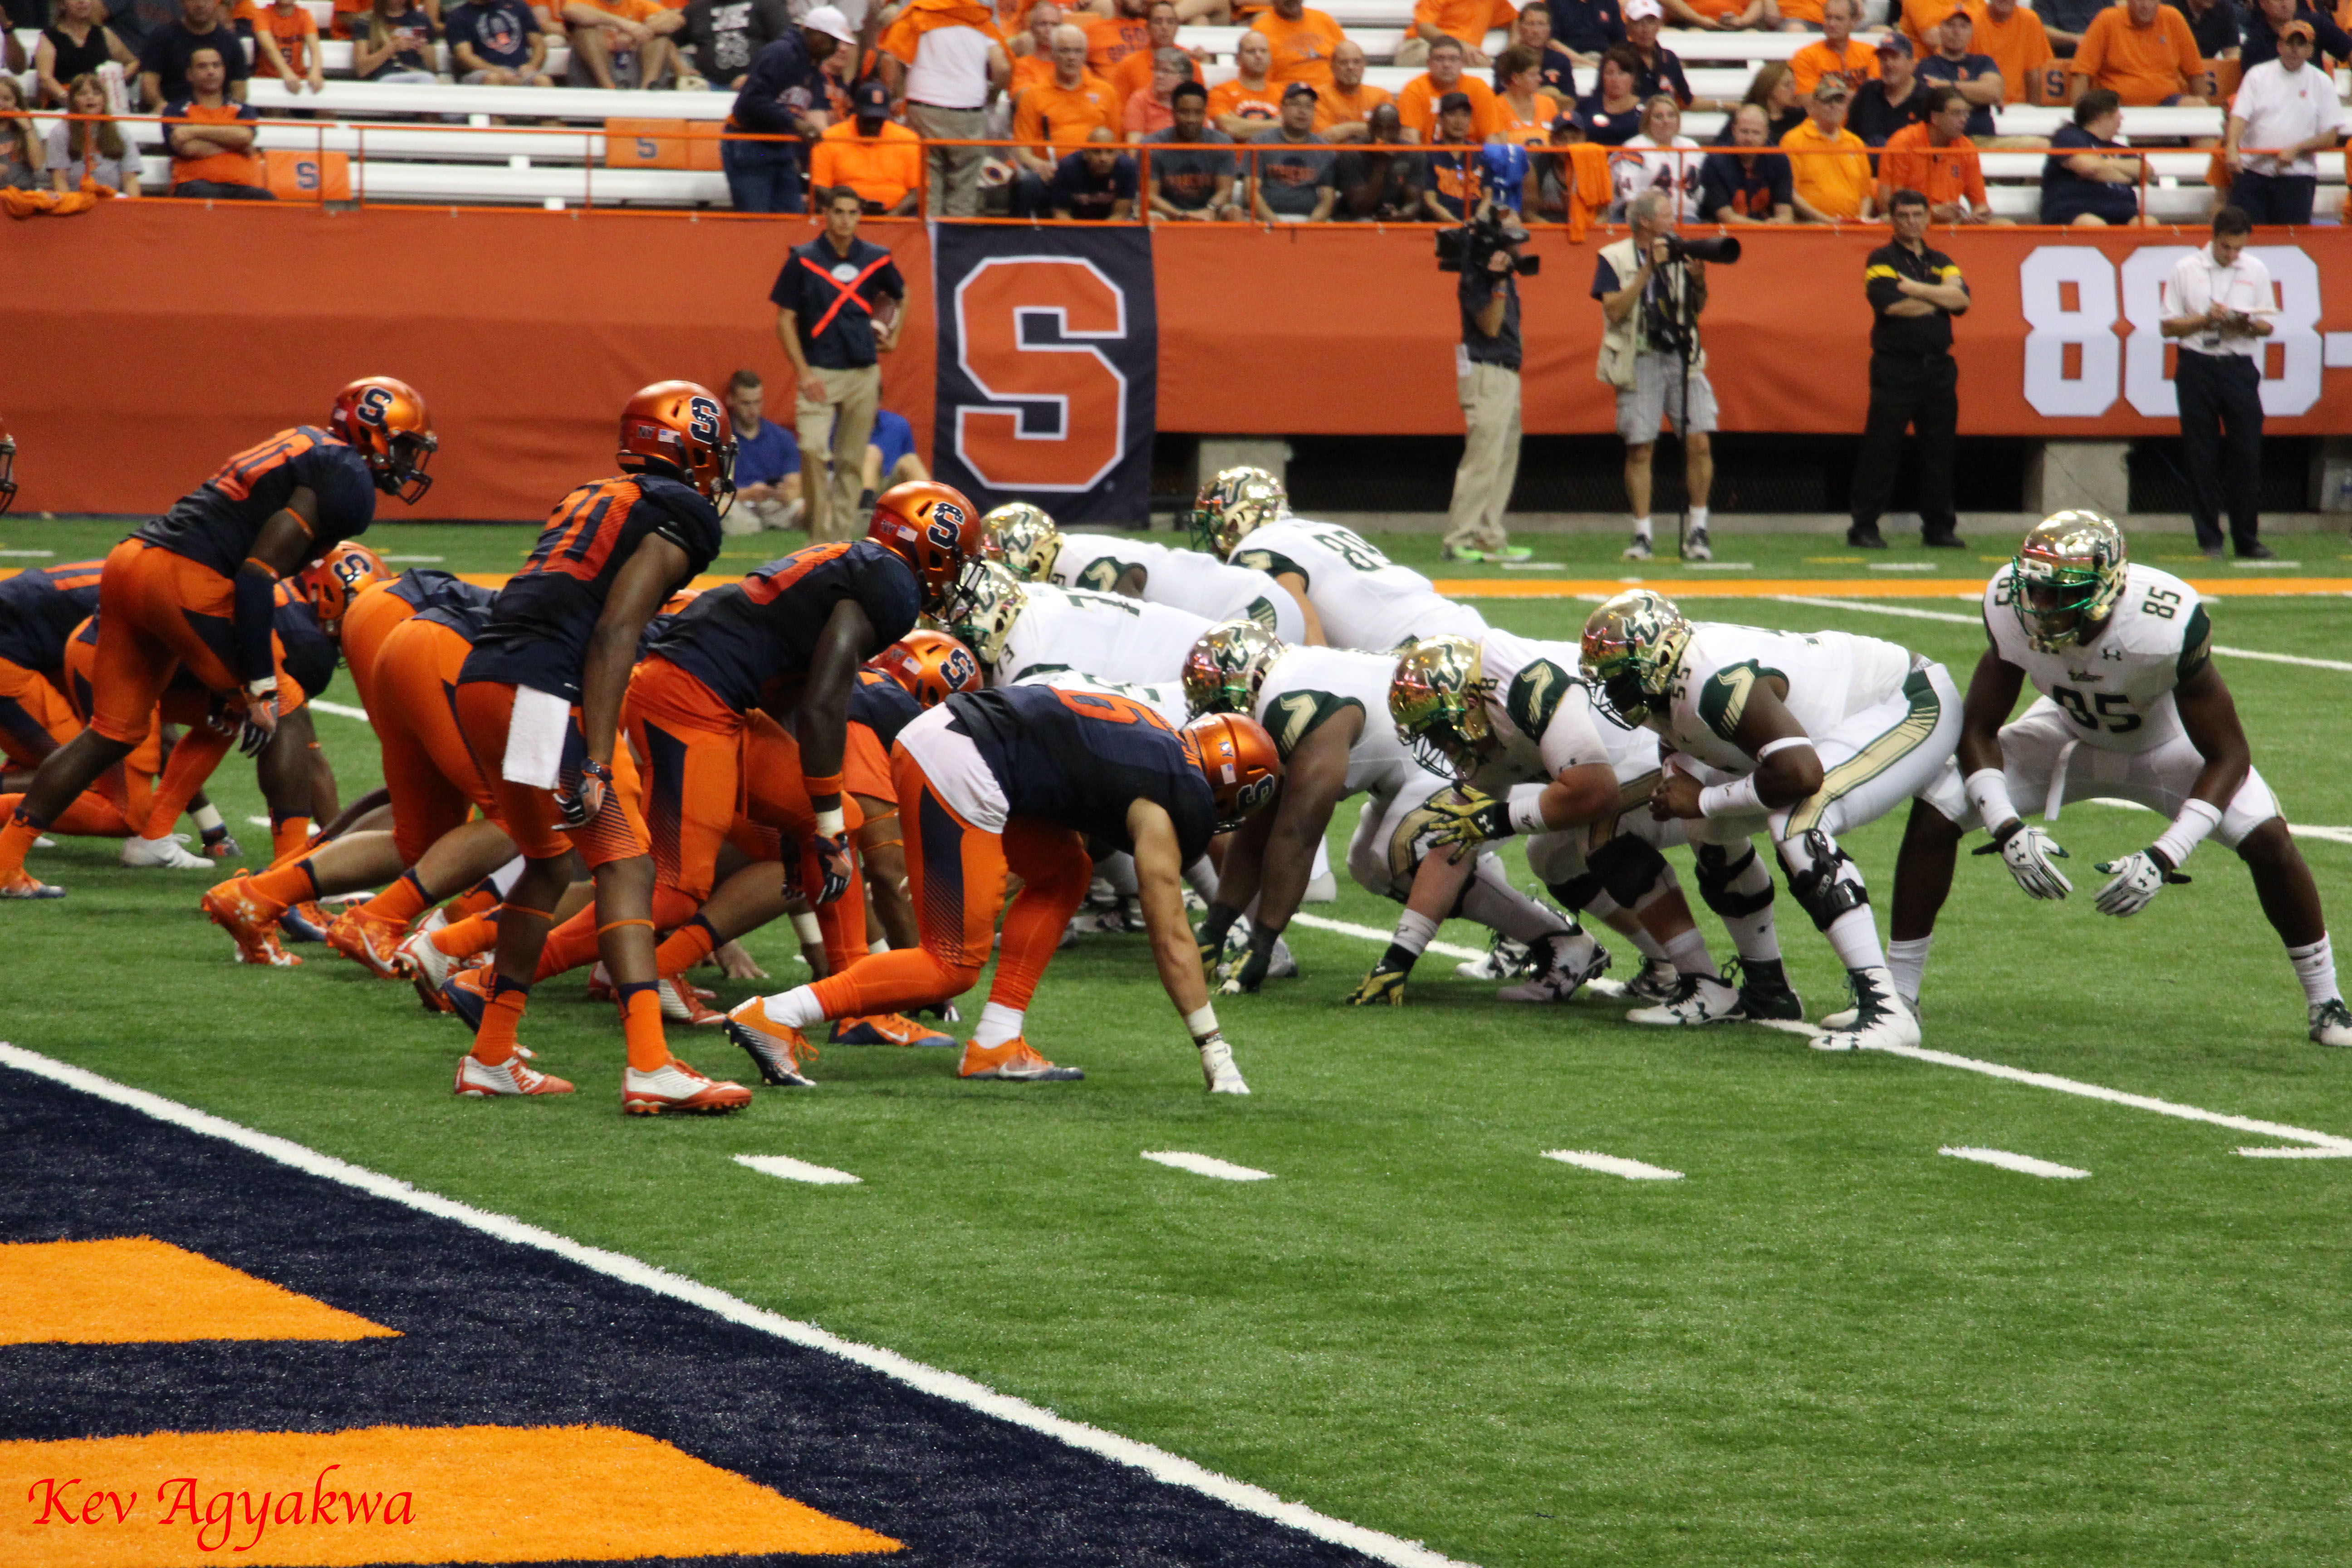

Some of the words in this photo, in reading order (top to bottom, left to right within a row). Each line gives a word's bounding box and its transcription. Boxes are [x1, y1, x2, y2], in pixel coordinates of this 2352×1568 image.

[2046, 70, 2065, 97] S
[637, 137, 657, 159] S
[296, 162, 320, 189] S
[955, 255, 1127, 493] S
[355, 387, 394, 426] S
[688, 396, 720, 445] S
[926, 501, 965, 549] S
[333, 553, 372, 585] S
[2141, 585, 2181, 620] 85
[940, 647, 975, 690] S
[1672, 666, 1691, 700] 55
[2052, 684, 2142, 734] 85
[1218, 741, 1235, 758] NY
[1236, 773, 1275, 816] S
